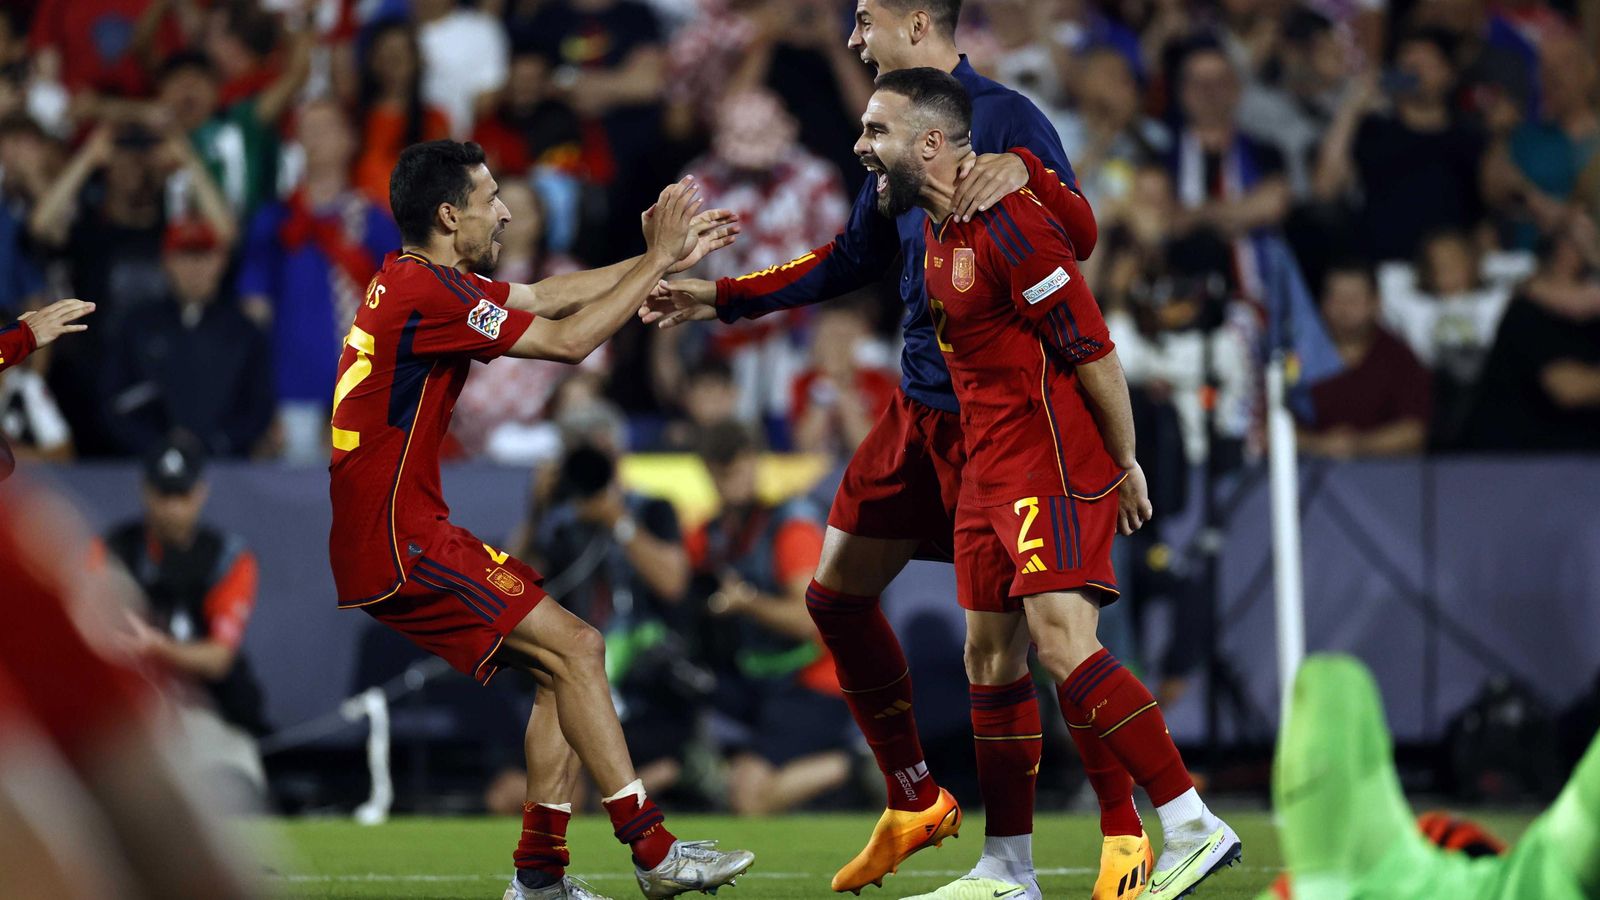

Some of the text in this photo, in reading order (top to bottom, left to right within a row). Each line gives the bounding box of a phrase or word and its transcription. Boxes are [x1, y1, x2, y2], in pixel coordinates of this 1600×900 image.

[1026, 272, 1067, 300] FOUNDATION
[1014, 496, 1044, 554] 2
[895, 769, 919, 801] EDESIGN
